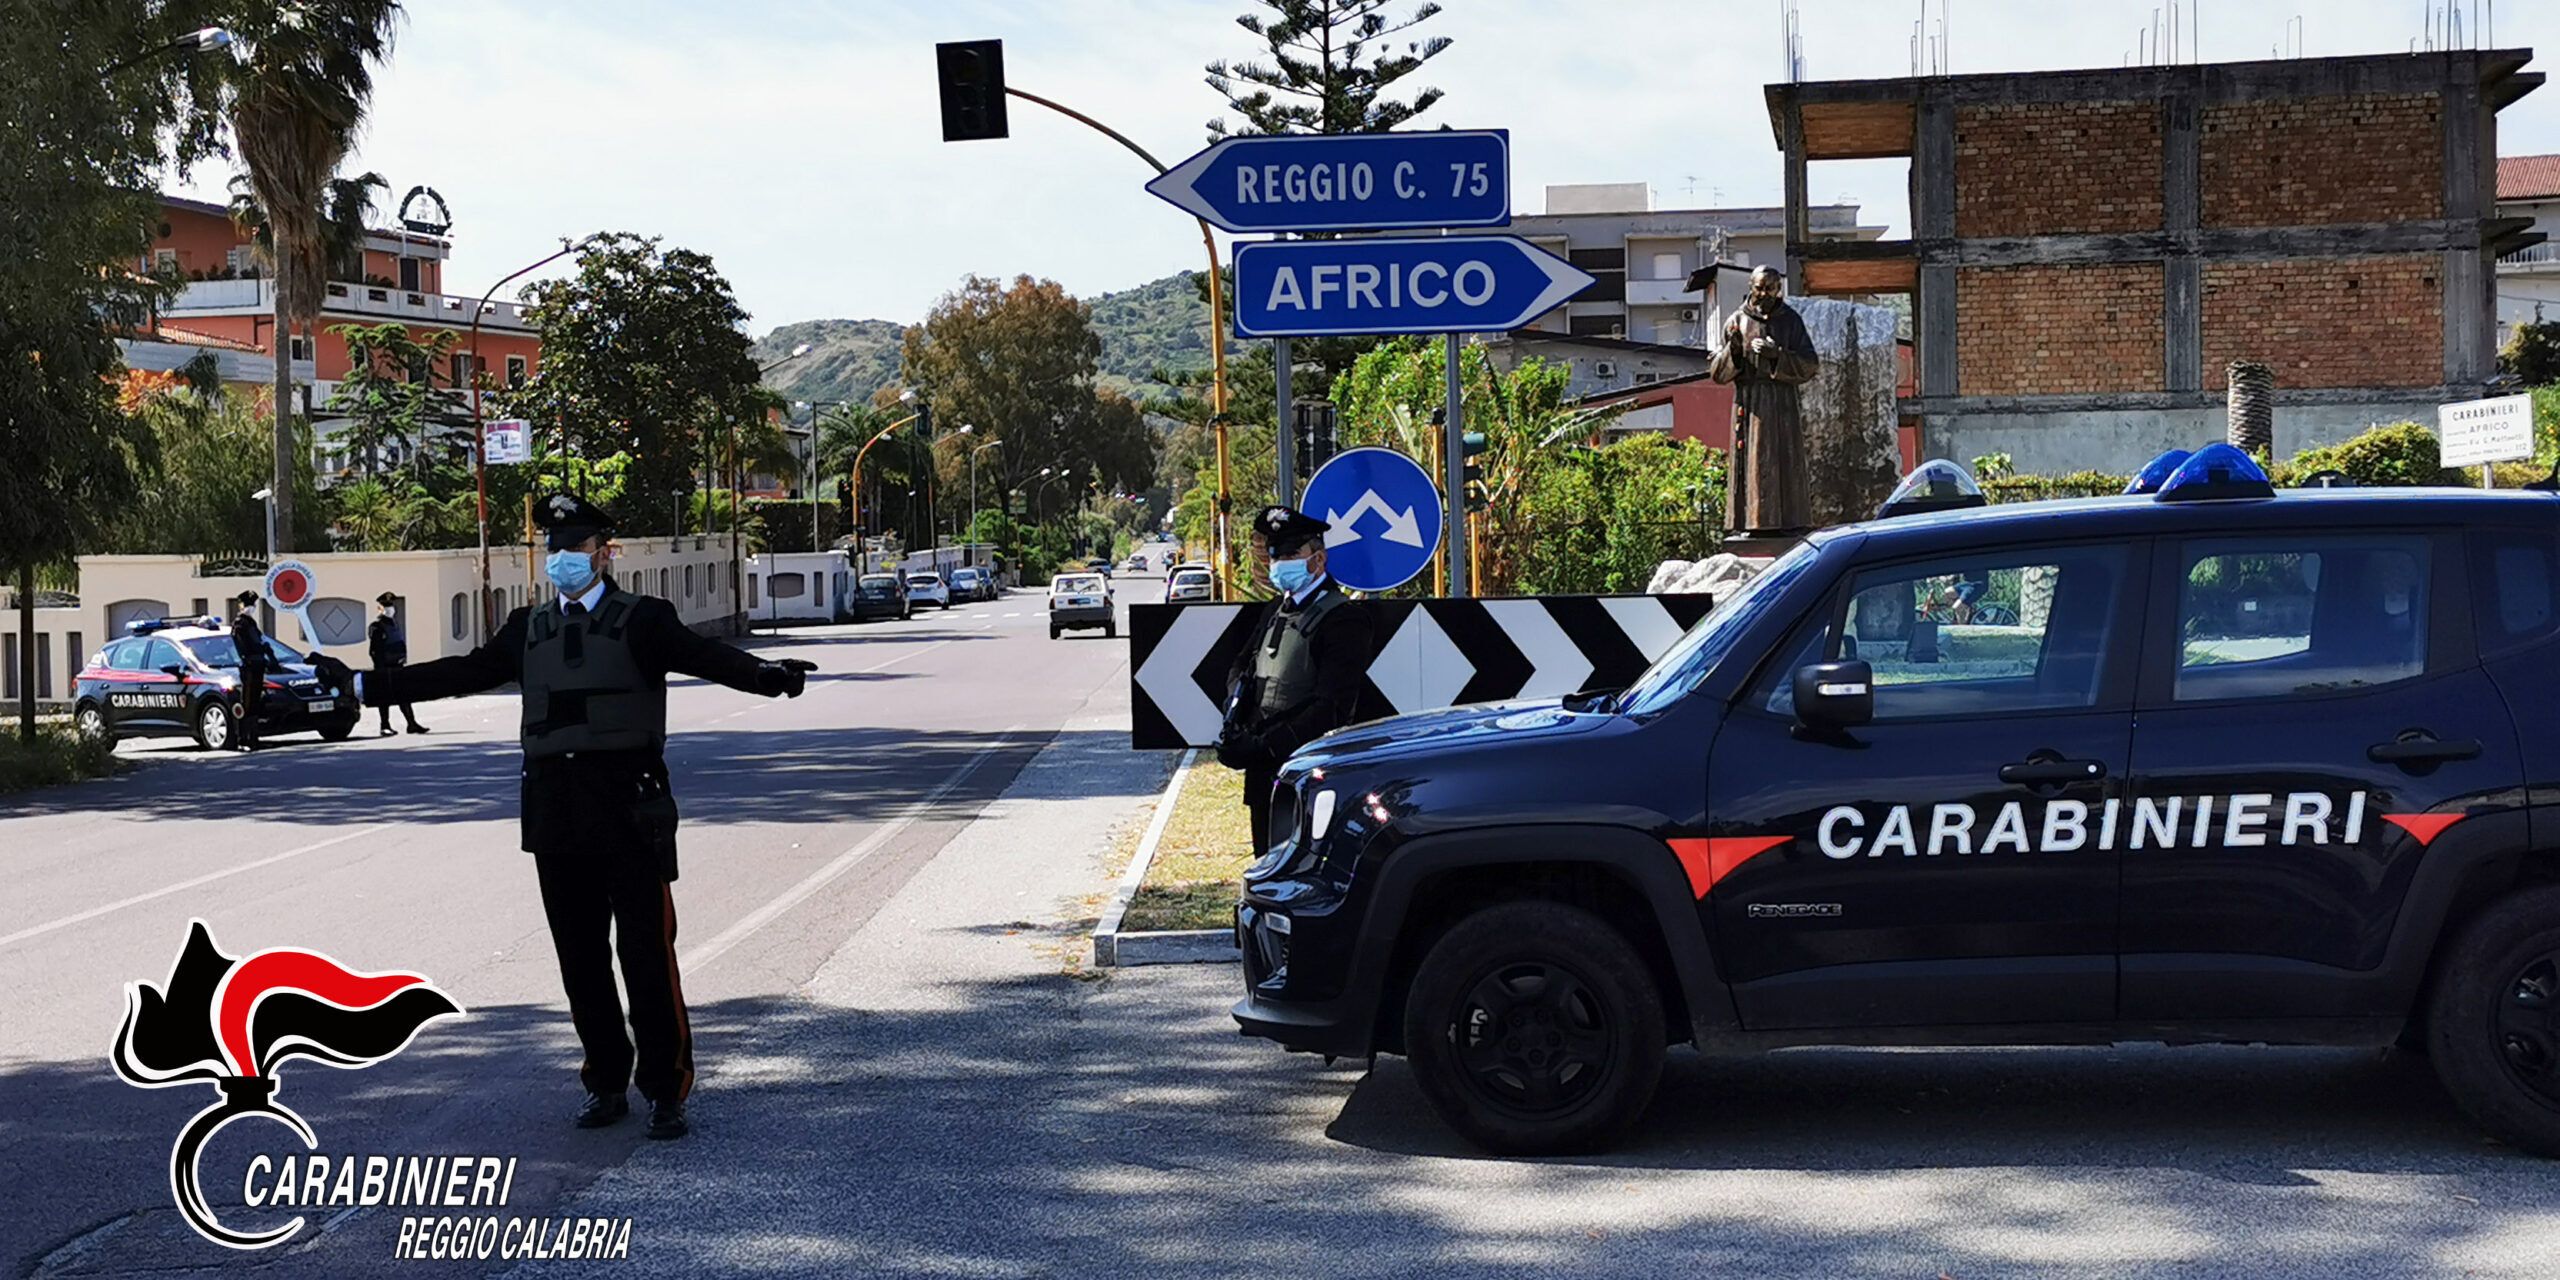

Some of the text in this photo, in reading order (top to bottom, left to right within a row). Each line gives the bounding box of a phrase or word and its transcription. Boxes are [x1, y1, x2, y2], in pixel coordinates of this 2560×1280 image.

[1237, 160, 1489, 204] REGGIO C. 75
[1265, 259, 1496, 312] AFRICO
[2452, 404, 2519, 421] CARABINIERI
[2469, 421, 2509, 433] AFRICO
[111, 693, 179, 708] CARABINIERI
[1817, 791, 2367, 859] CARABINIERI
[1747, 902, 1842, 917] RENEGADE
